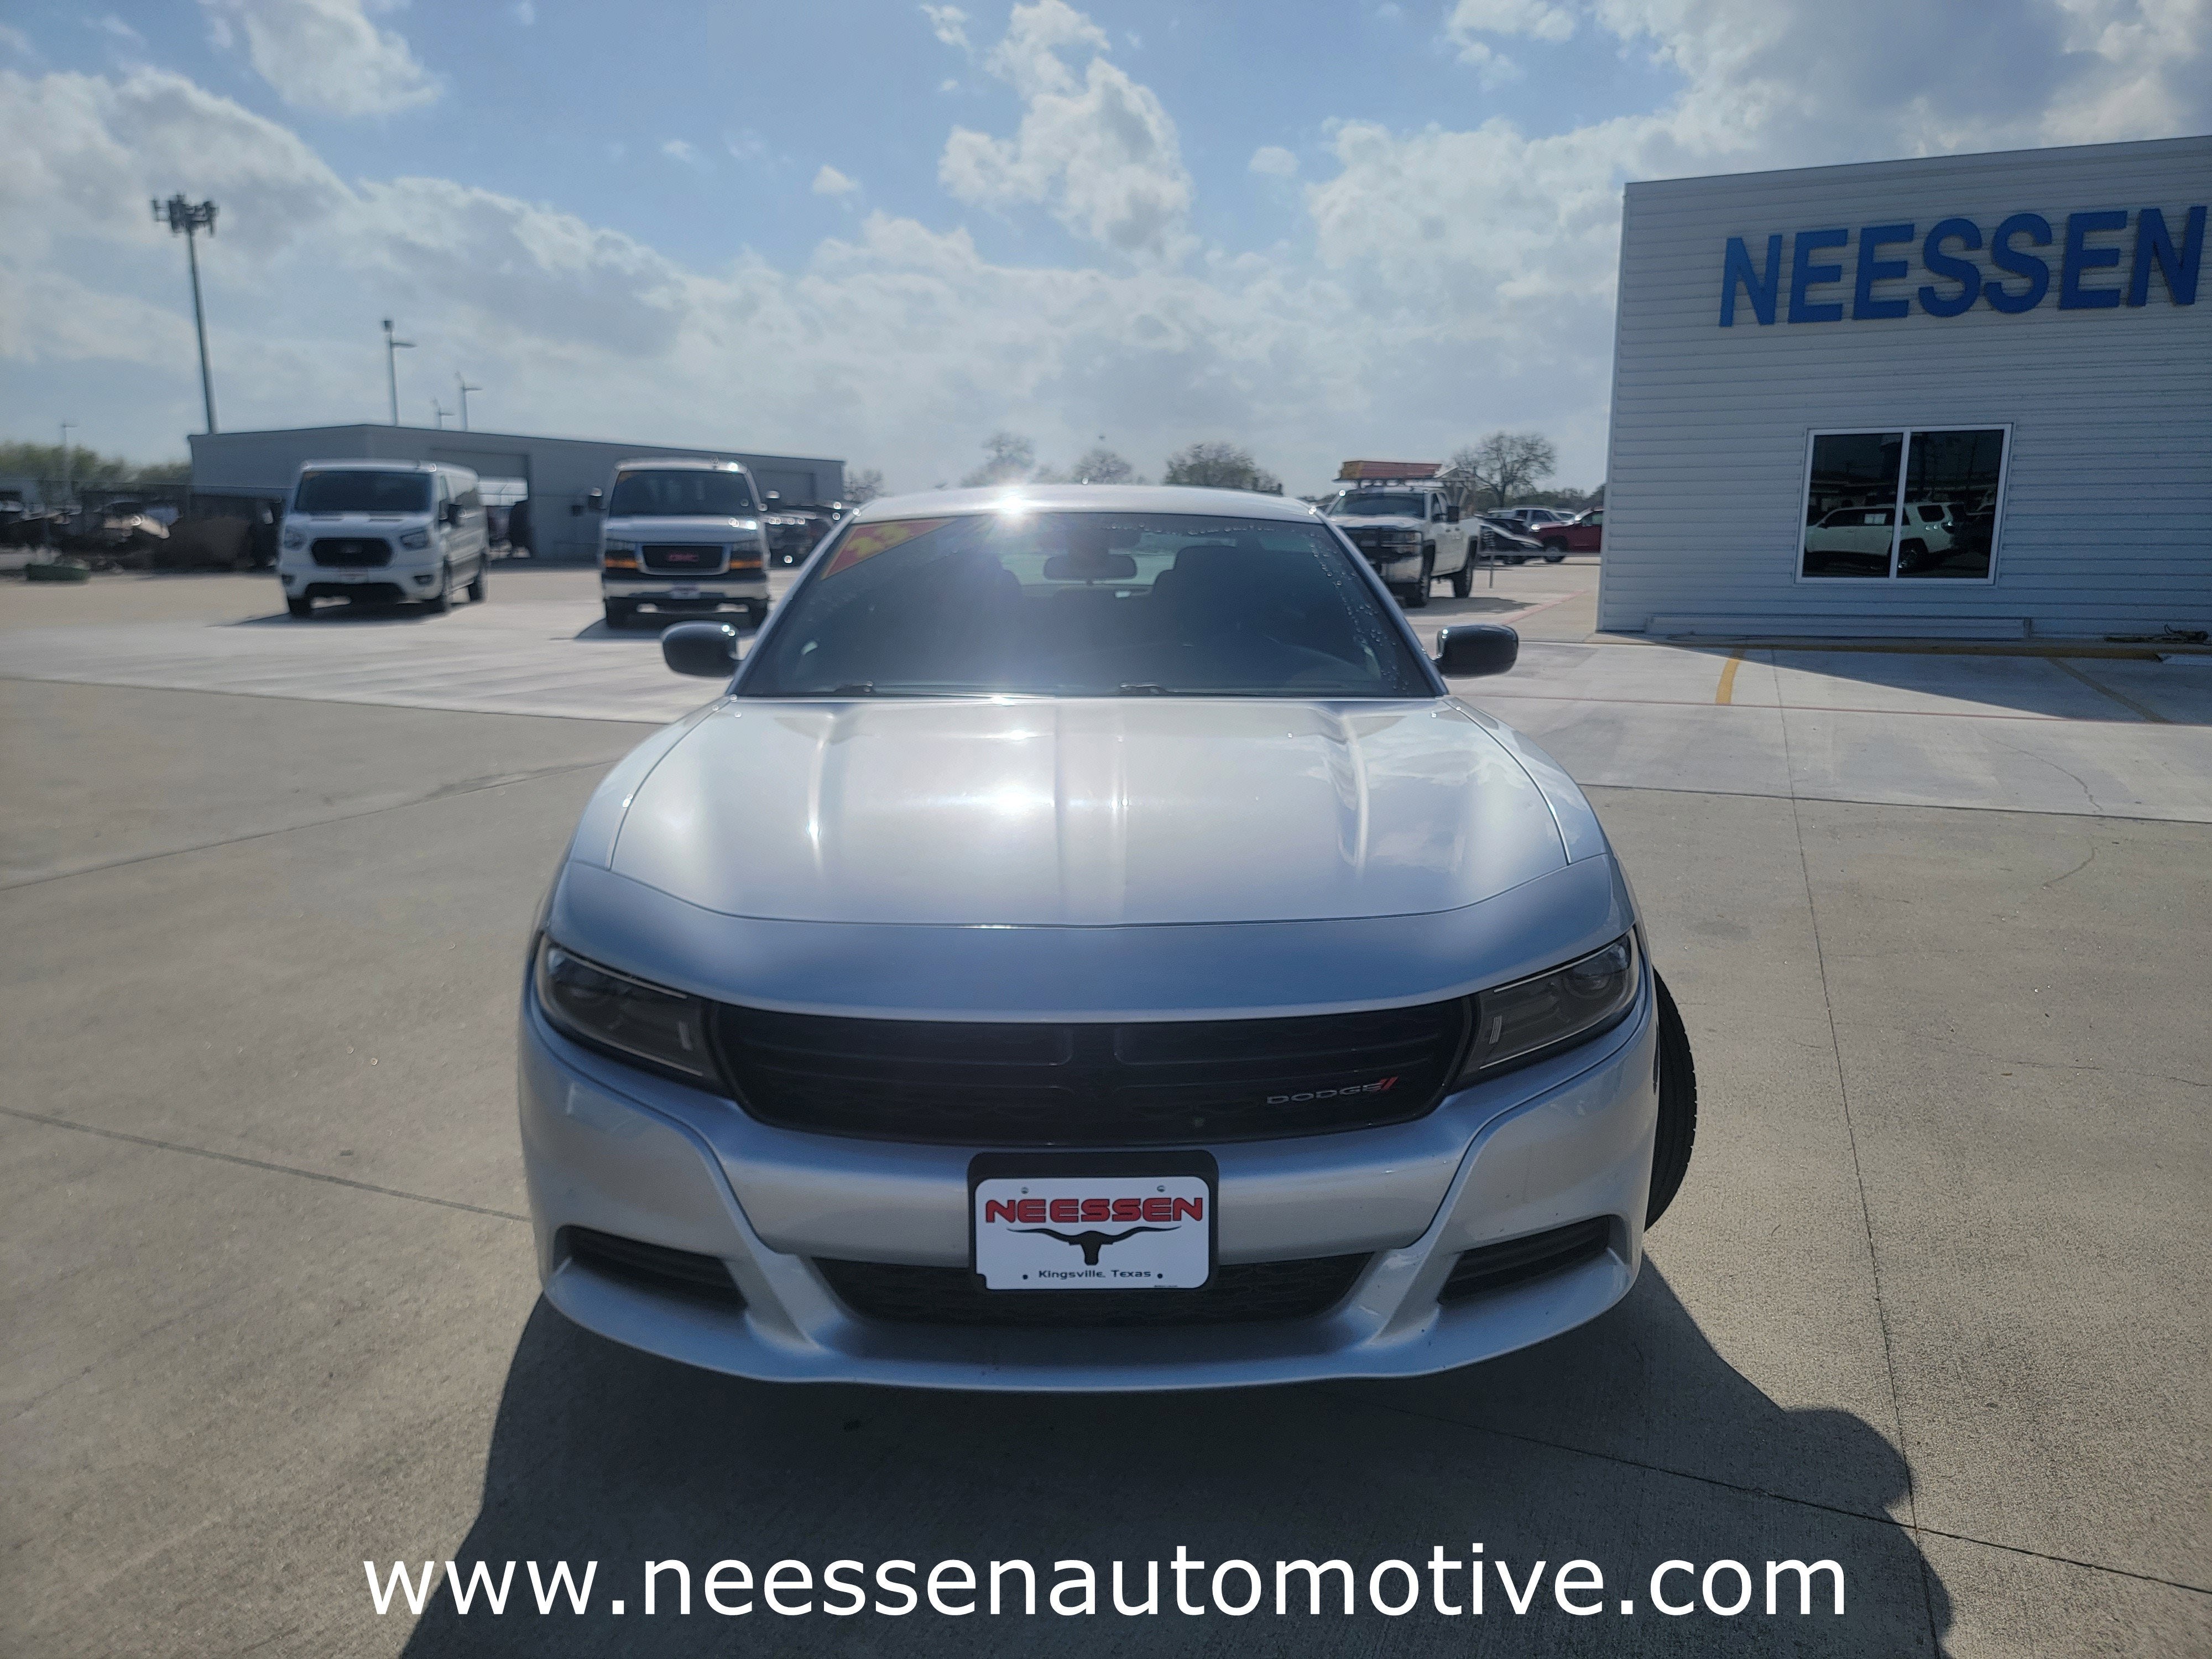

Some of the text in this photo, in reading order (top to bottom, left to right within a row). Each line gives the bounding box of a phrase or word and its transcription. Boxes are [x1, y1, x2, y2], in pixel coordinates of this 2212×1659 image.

[1719, 206, 2208, 327] NEESSEN
[1266, 1082, 1383, 1104] DODGE
[985, 1197, 1203, 1223] NEESSEN
[1111, 1270, 1151, 1278] Texas
